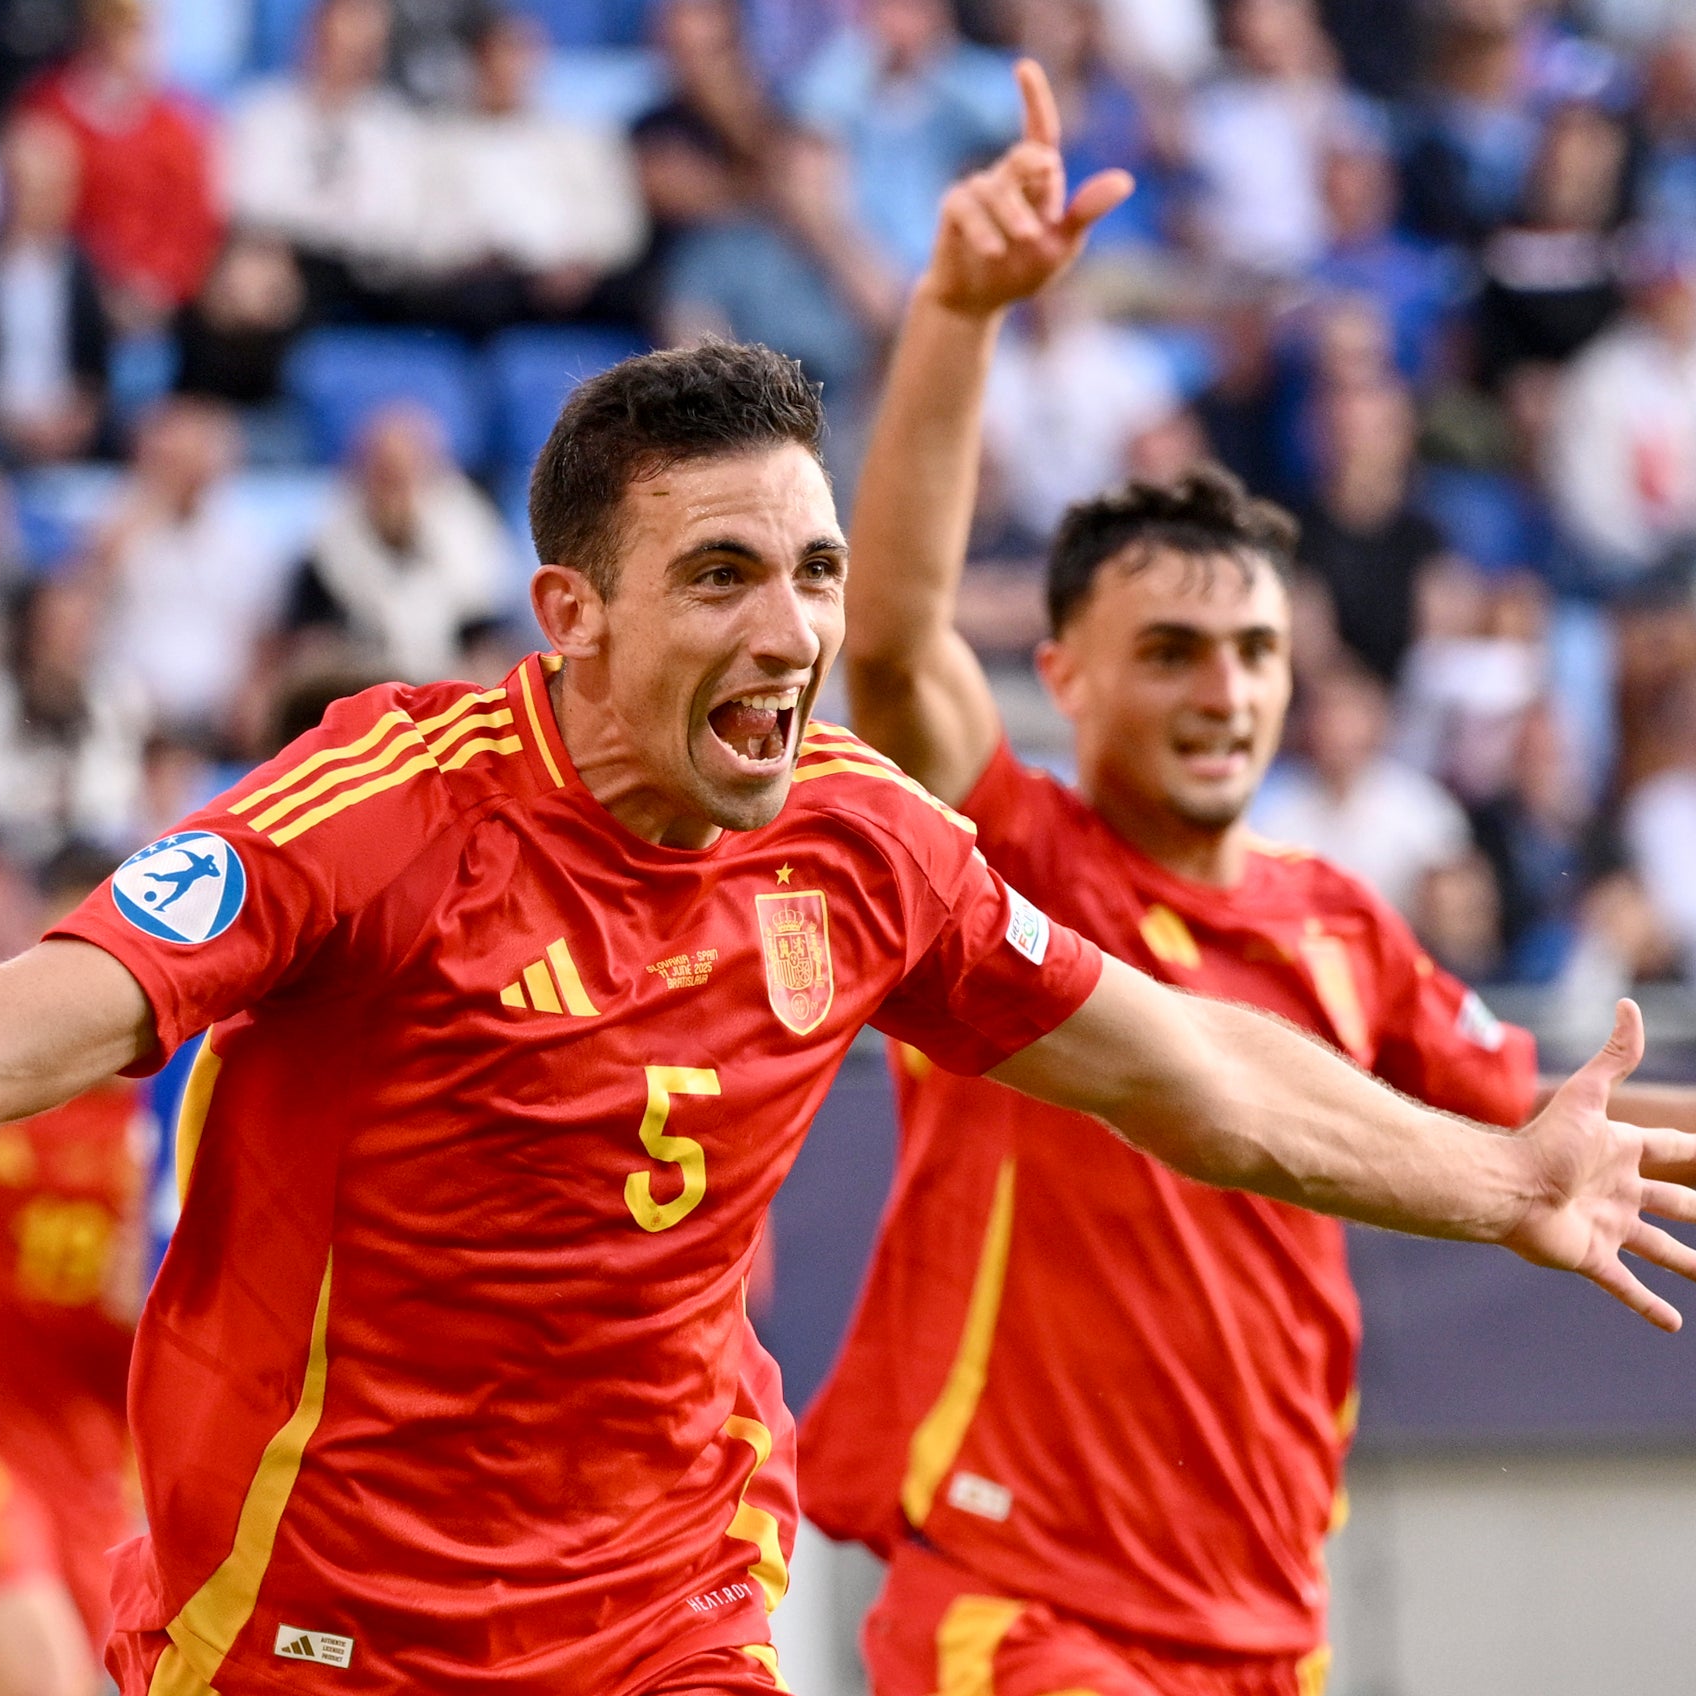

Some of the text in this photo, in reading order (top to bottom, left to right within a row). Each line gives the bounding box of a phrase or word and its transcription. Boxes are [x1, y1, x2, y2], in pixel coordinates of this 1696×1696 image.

[646, 954, 690, 974] SLOVAKIA
[696, 949, 719, 962] SPAIN
[658, 961, 713, 979] 11 JUNE 2025
[667, 974, 709, 989] BRATISLAVA
[624, 1065, 722, 1232] 5
[686, 1583, 753, 1612] HEAT.RDY
